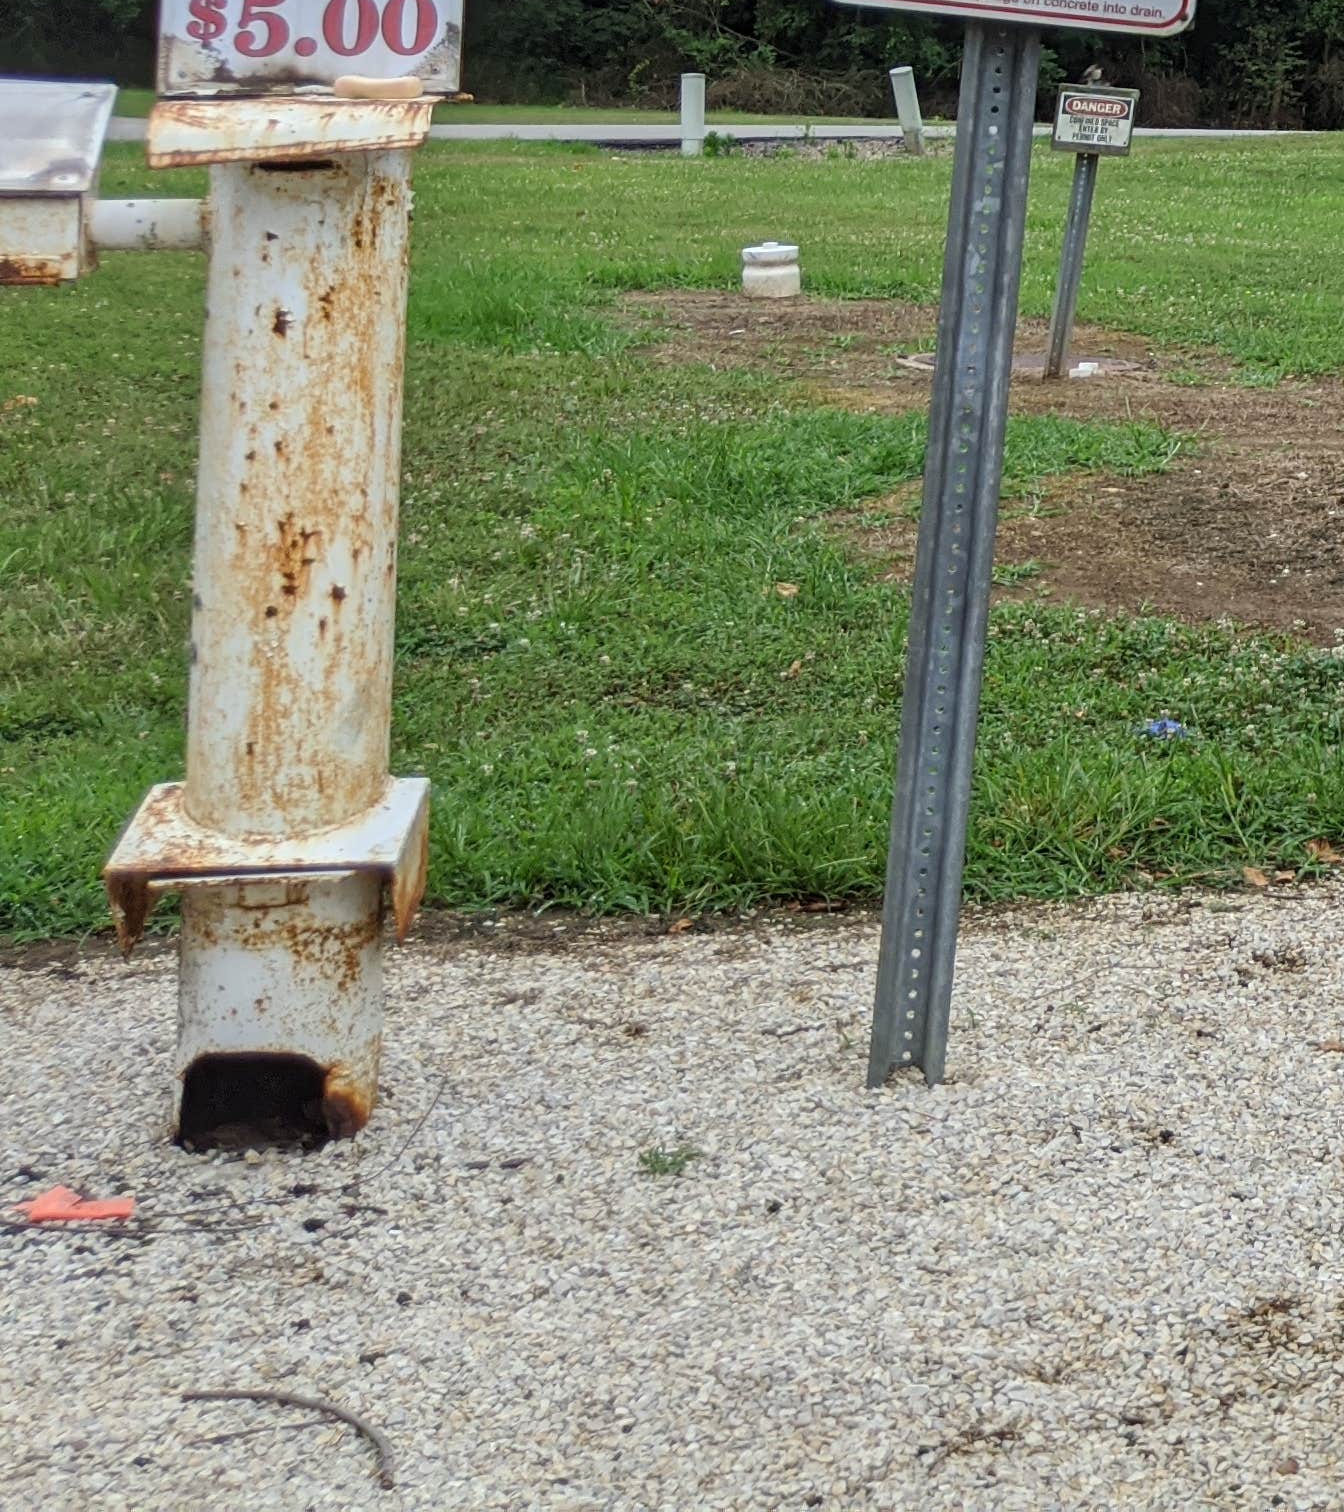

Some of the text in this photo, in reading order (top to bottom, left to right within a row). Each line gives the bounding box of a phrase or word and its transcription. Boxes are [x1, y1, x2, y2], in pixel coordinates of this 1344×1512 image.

[1103, 1, 1127, 15] into
[1130, 4, 1166, 20] drain.
[1072, 100, 1121, 114] DANGER
